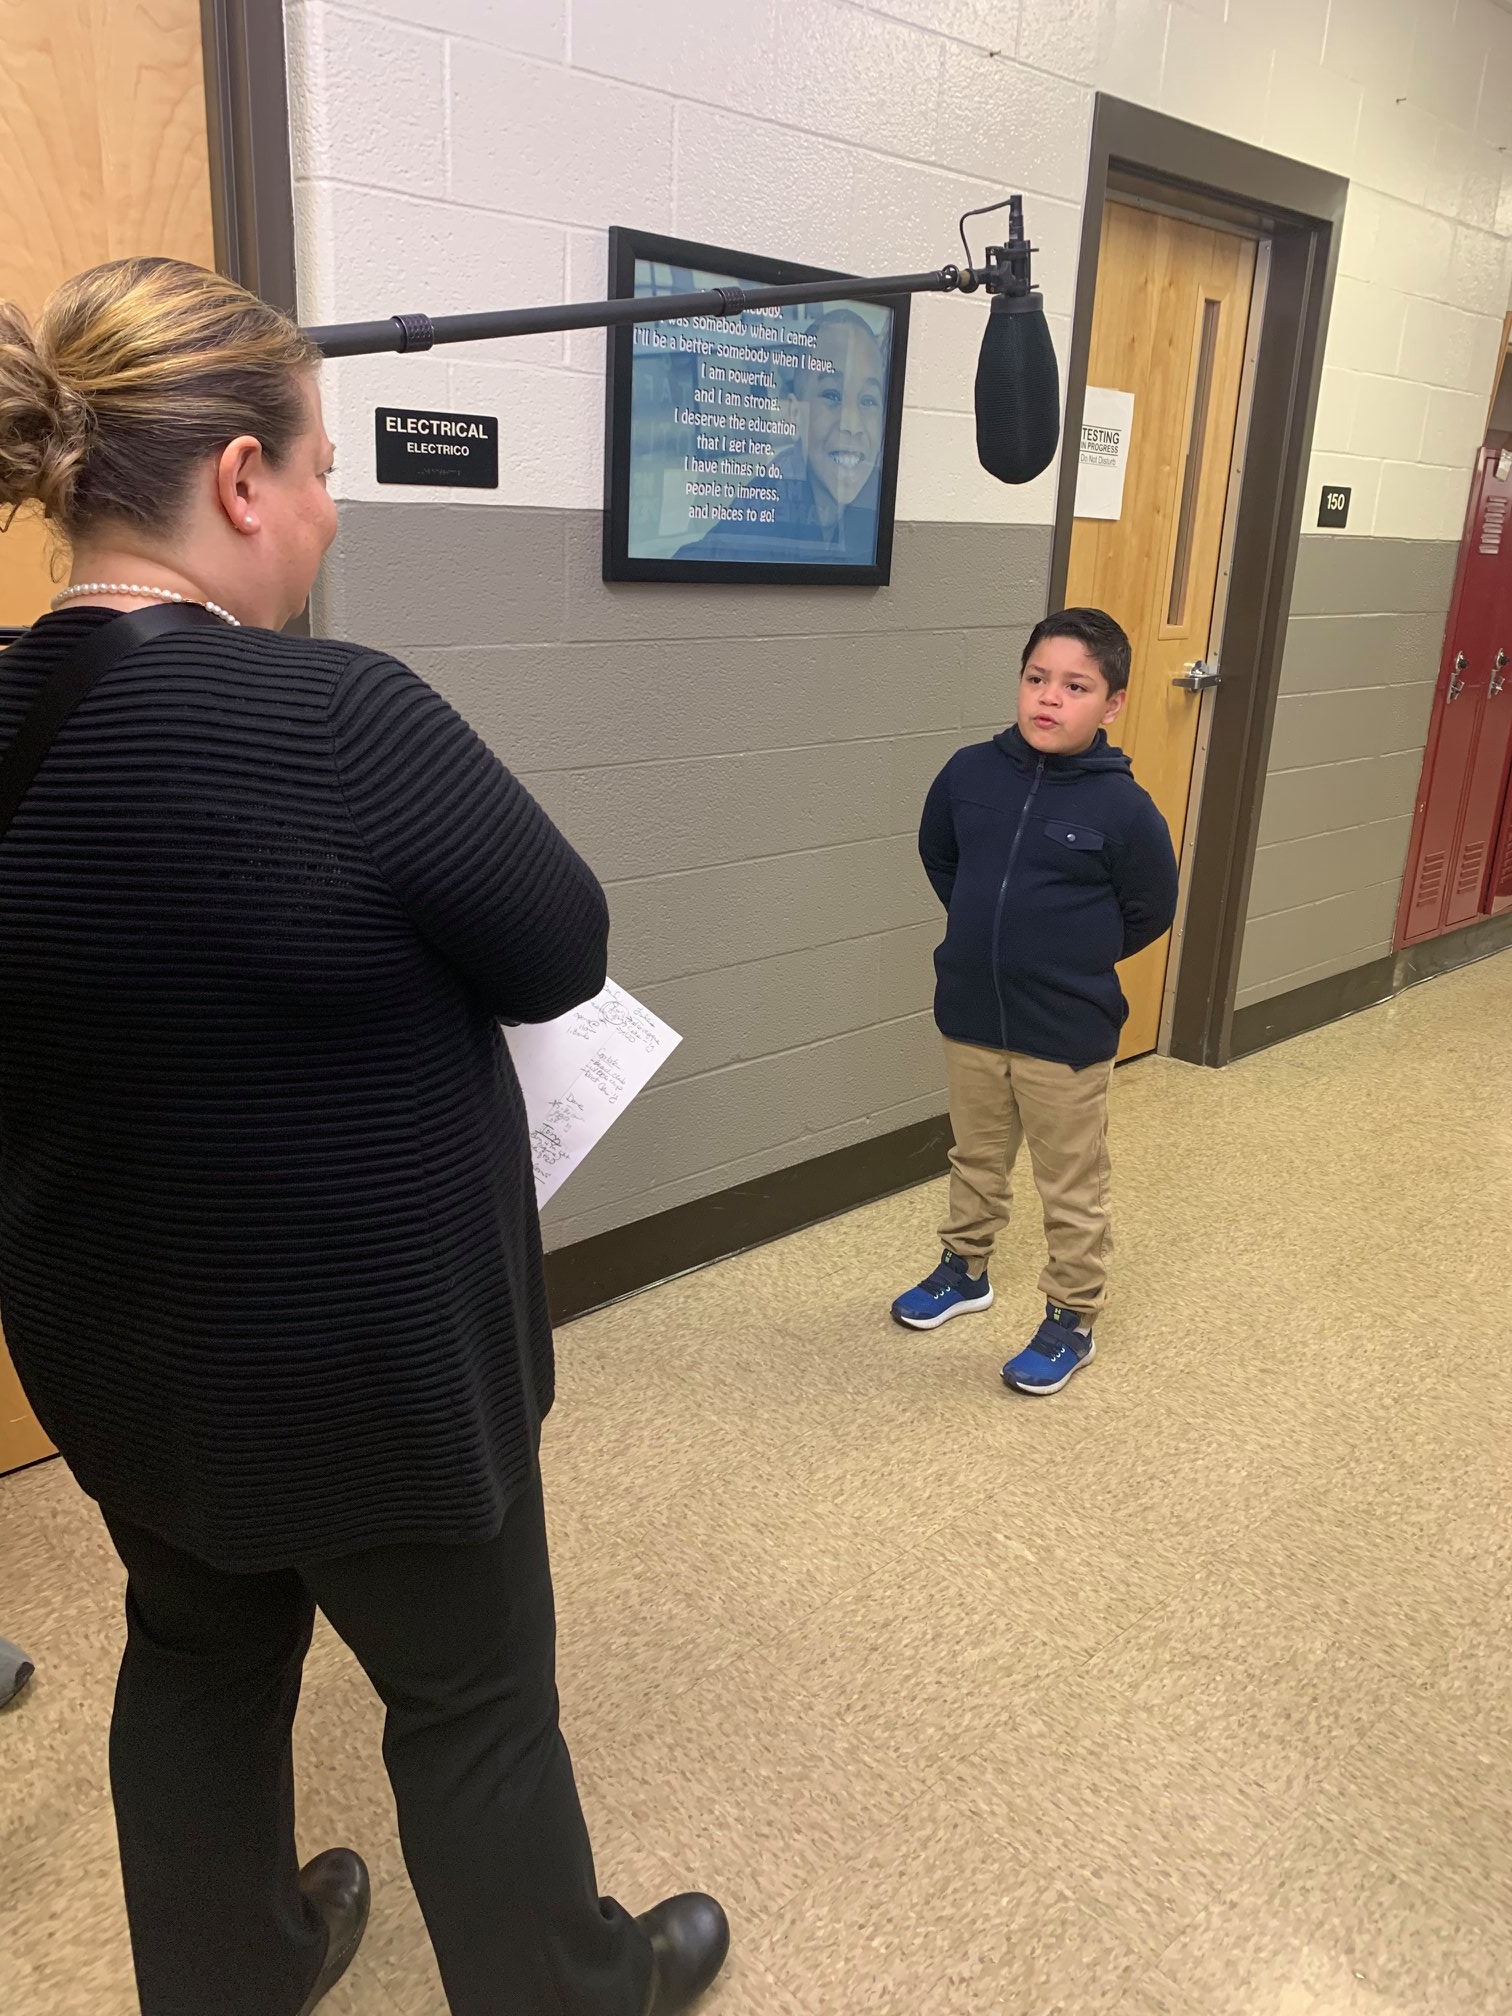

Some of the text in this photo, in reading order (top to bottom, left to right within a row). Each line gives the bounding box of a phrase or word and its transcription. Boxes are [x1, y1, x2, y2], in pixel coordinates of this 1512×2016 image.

[692, 316, 748, 336] somebody
[750, 322, 778, 342] when
[780, 327, 785, 343] I
[786, 331, 817, 348] came;
[633, 328, 835, 374] I'll be a better somebody when I leave.
[701, 363, 706, 379] I
[709, 366, 725, 381] am
[694, 388, 715, 404] and
[718, 389, 723, 405] I
[725, 392, 741, 407] am
[744, 394, 780, 411] strong.
[385, 416, 489, 439] ELECTRICAL
[674, 407, 796, 436] I deserve the education
[696, 433, 775, 456] that I get here.
[1082, 427, 1120, 445] TESTING
[407, 442, 470, 457] ELECTRICO
[1080, 441, 1119, 454] IN PROGRESS
[684, 456, 689, 472] I
[691, 456, 718, 473] have
[720, 458, 752, 476] things
[755, 463, 766, 478] to
[685, 480, 780, 502] people to impress,
[1327, 493, 1346, 511] 150
[688, 503, 775, 523] and places to go!
